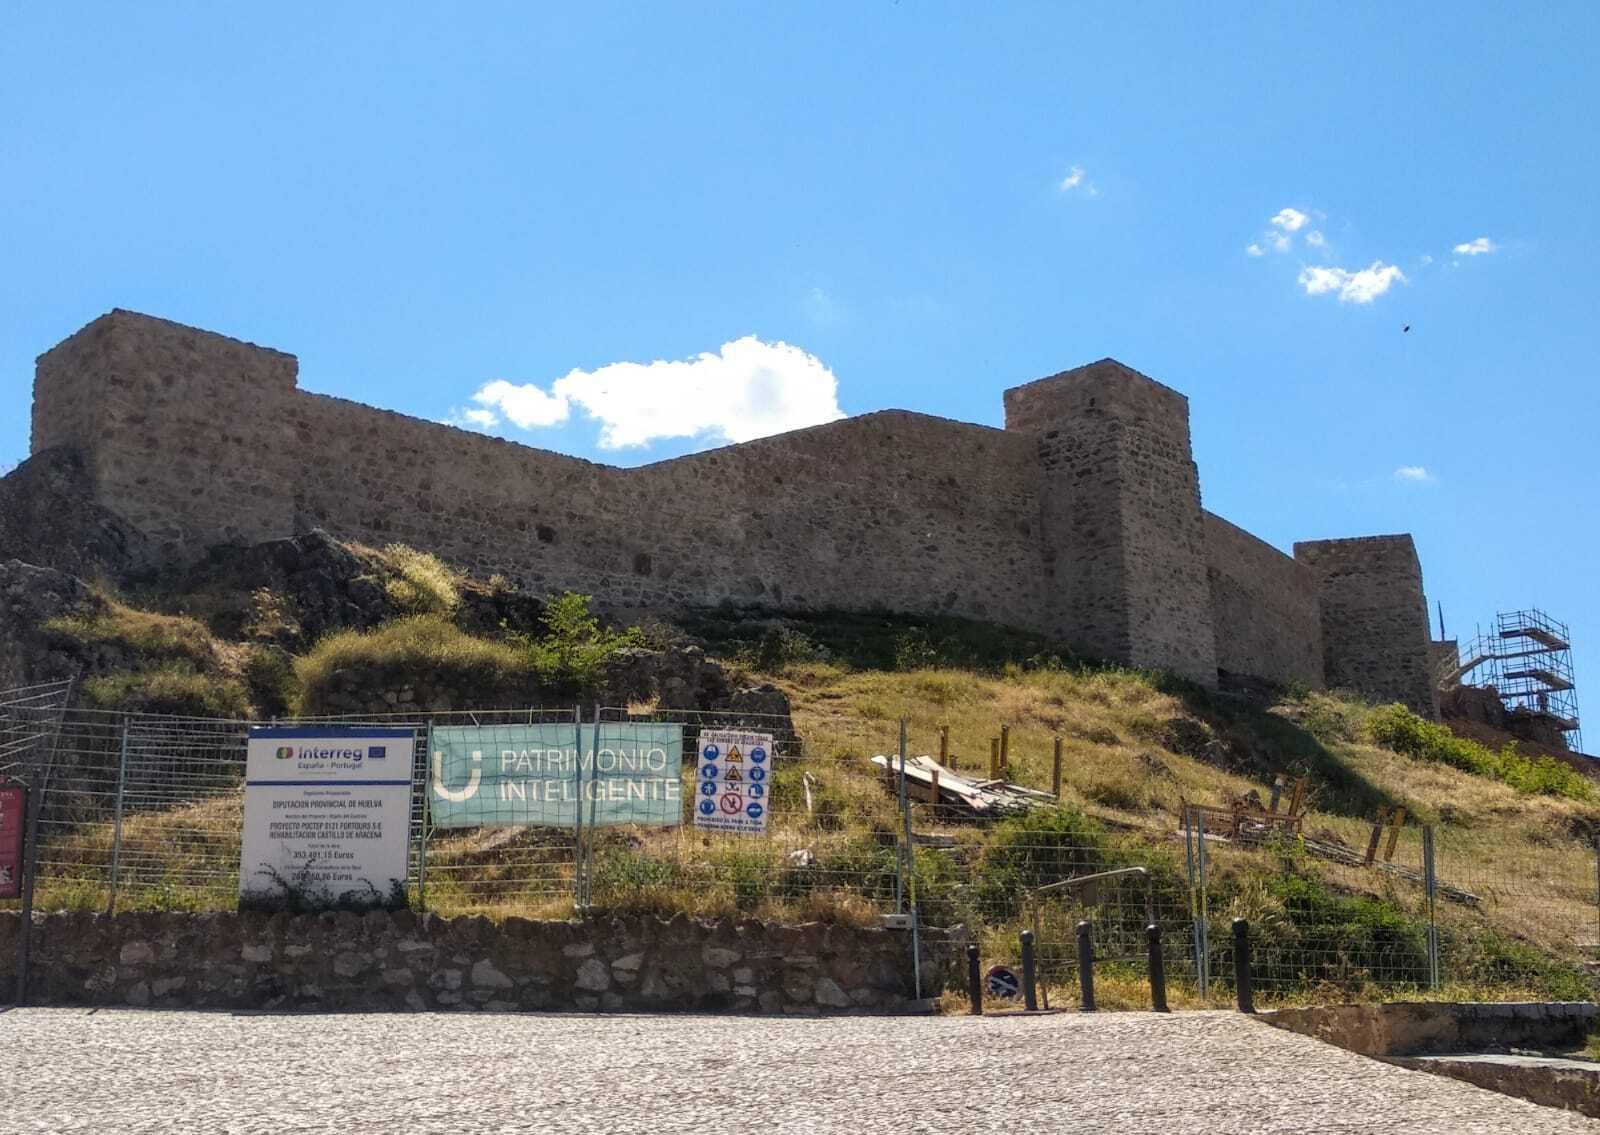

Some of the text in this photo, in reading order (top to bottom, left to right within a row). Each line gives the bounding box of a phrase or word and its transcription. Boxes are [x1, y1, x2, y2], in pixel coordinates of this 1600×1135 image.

[298, 746, 363, 762] Interreg
[501, 748, 667, 773] PATRIMONIO
[331, 762, 363, 770] Portugal
[501, 778, 681, 802] INTELIGENTE
[311, 799, 346, 809] PROVINCIAL
[348, 799, 357, 809] DE
[358, 799, 383, 809] HUELVA
[270, 821, 301, 830] PROYECTO
[317, 831, 345, 840] CASTILLO
[345, 831, 354, 840] DE
[355, 831, 382, 840] ARACENA
[334, 850, 354, 860] Euros
[332, 871, 353, 881] Euros
